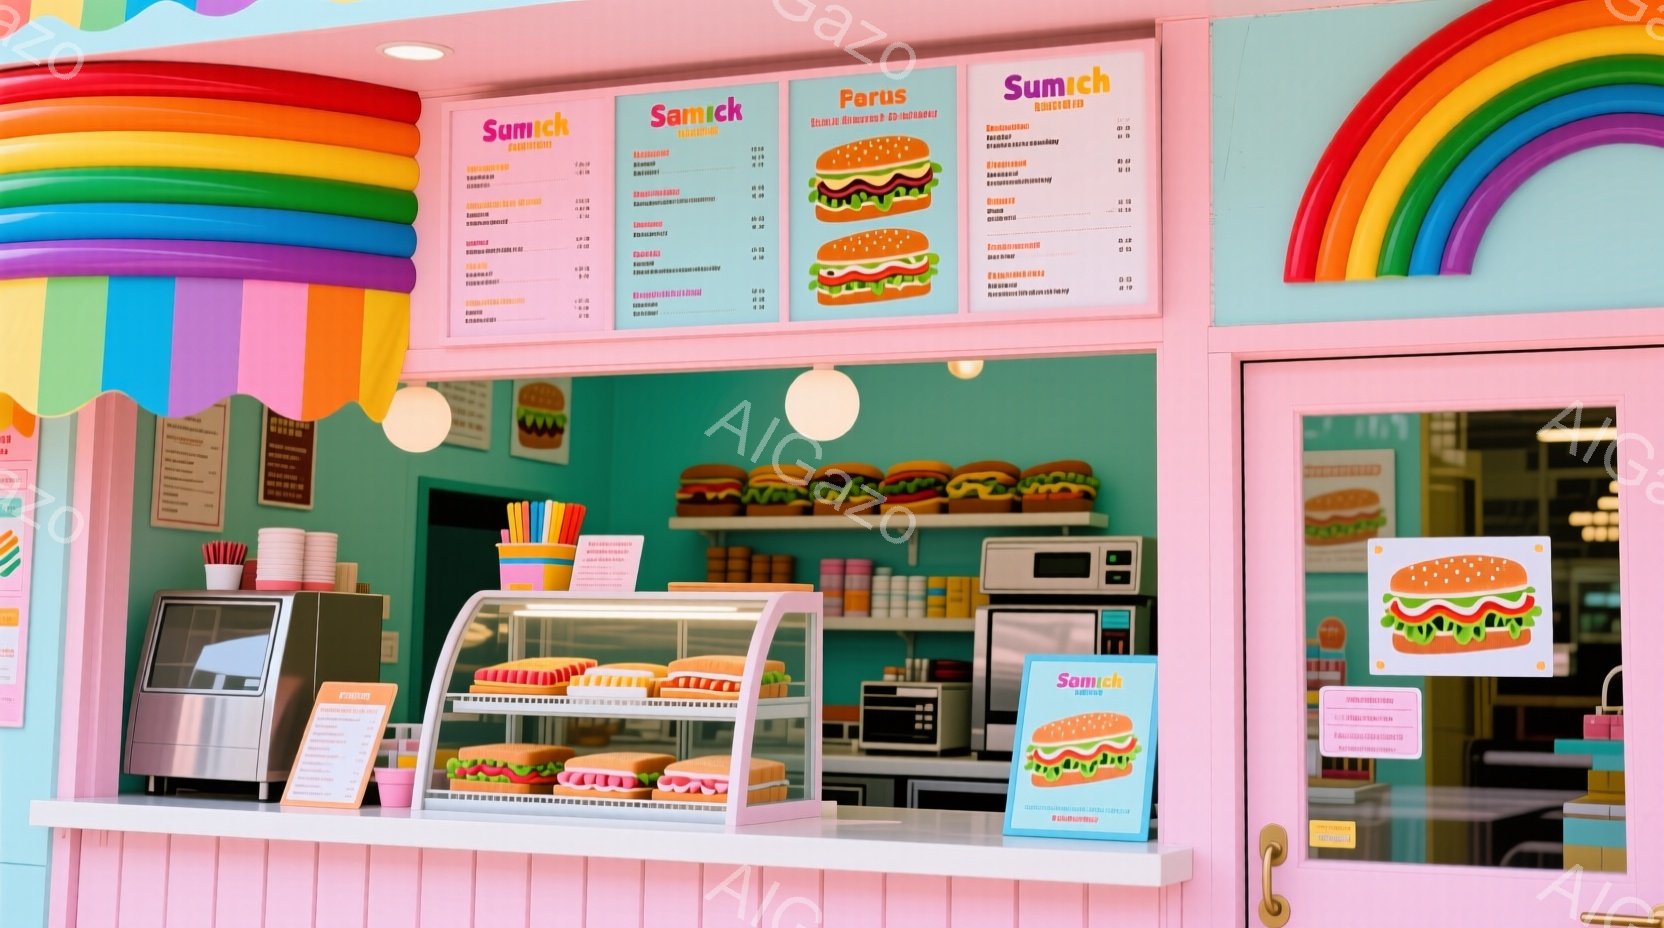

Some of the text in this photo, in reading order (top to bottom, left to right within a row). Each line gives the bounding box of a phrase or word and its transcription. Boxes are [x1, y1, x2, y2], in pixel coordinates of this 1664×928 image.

[1004, 66, 1111, 101] Sumich
[650, 97, 743, 128] Samick
[1056, 672, 1123, 689] Samich
